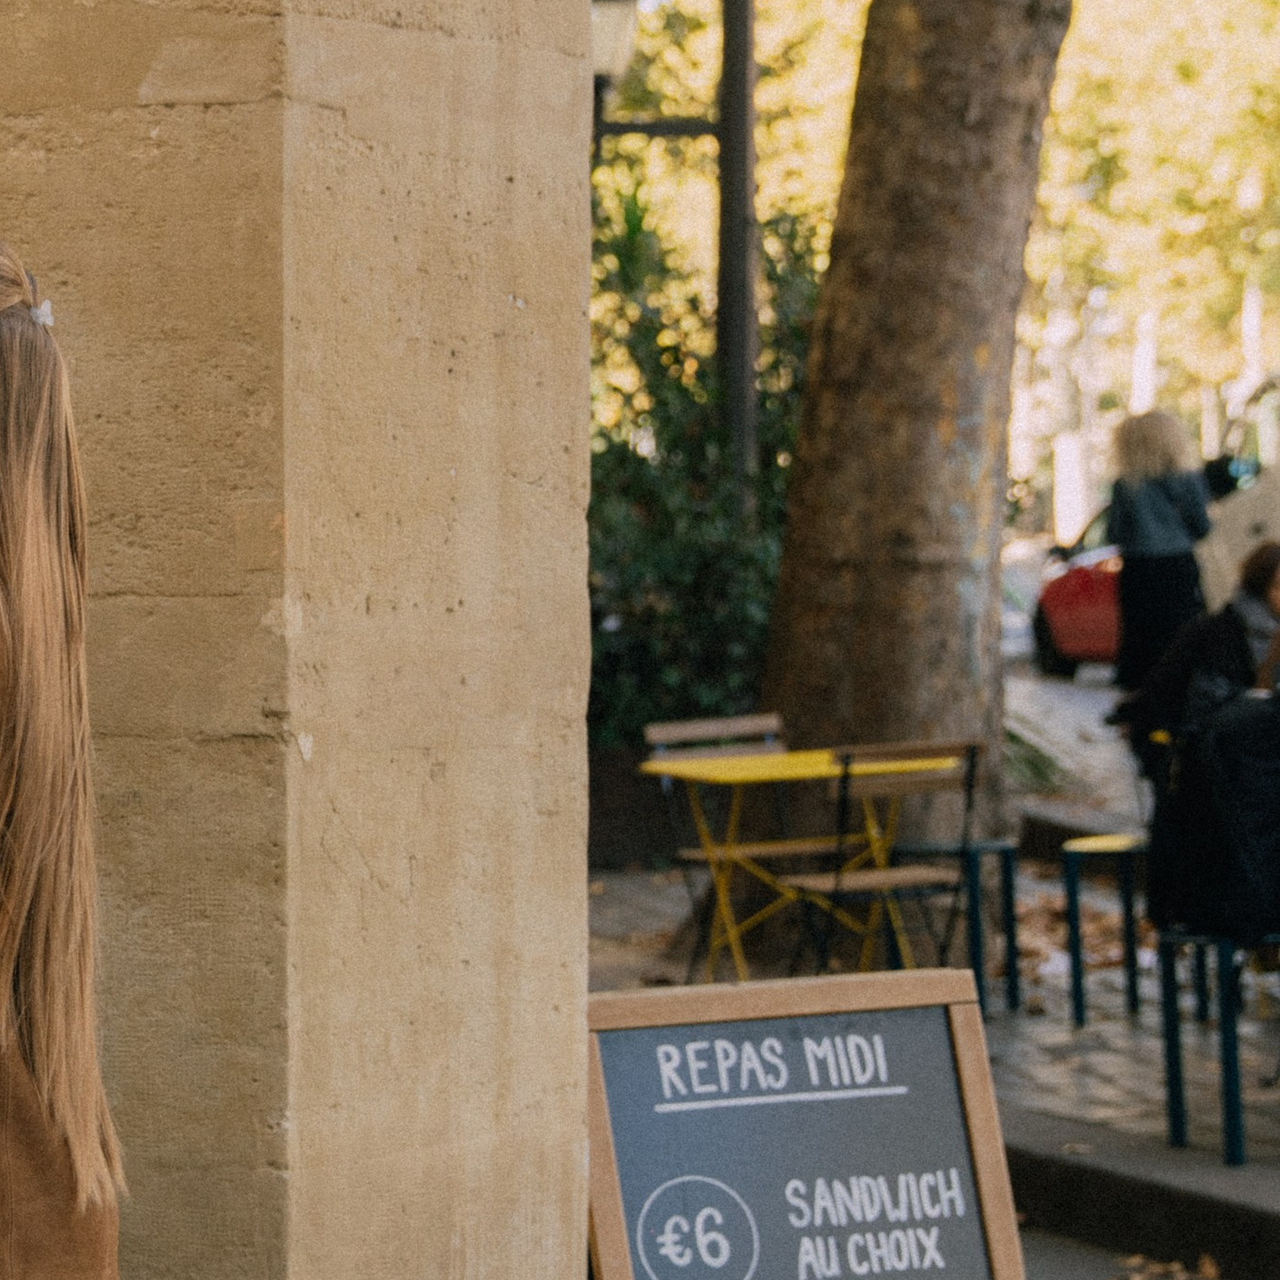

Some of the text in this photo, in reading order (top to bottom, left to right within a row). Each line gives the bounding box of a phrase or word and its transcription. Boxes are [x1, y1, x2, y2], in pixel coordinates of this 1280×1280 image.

[656, 1034, 888, 1098] REPAS MIDI
[785, 1168, 965, 1228] SANDWICH
[656, 1206, 731, 1268] €6
[847, 1226, 945, 1275] CHOIX
